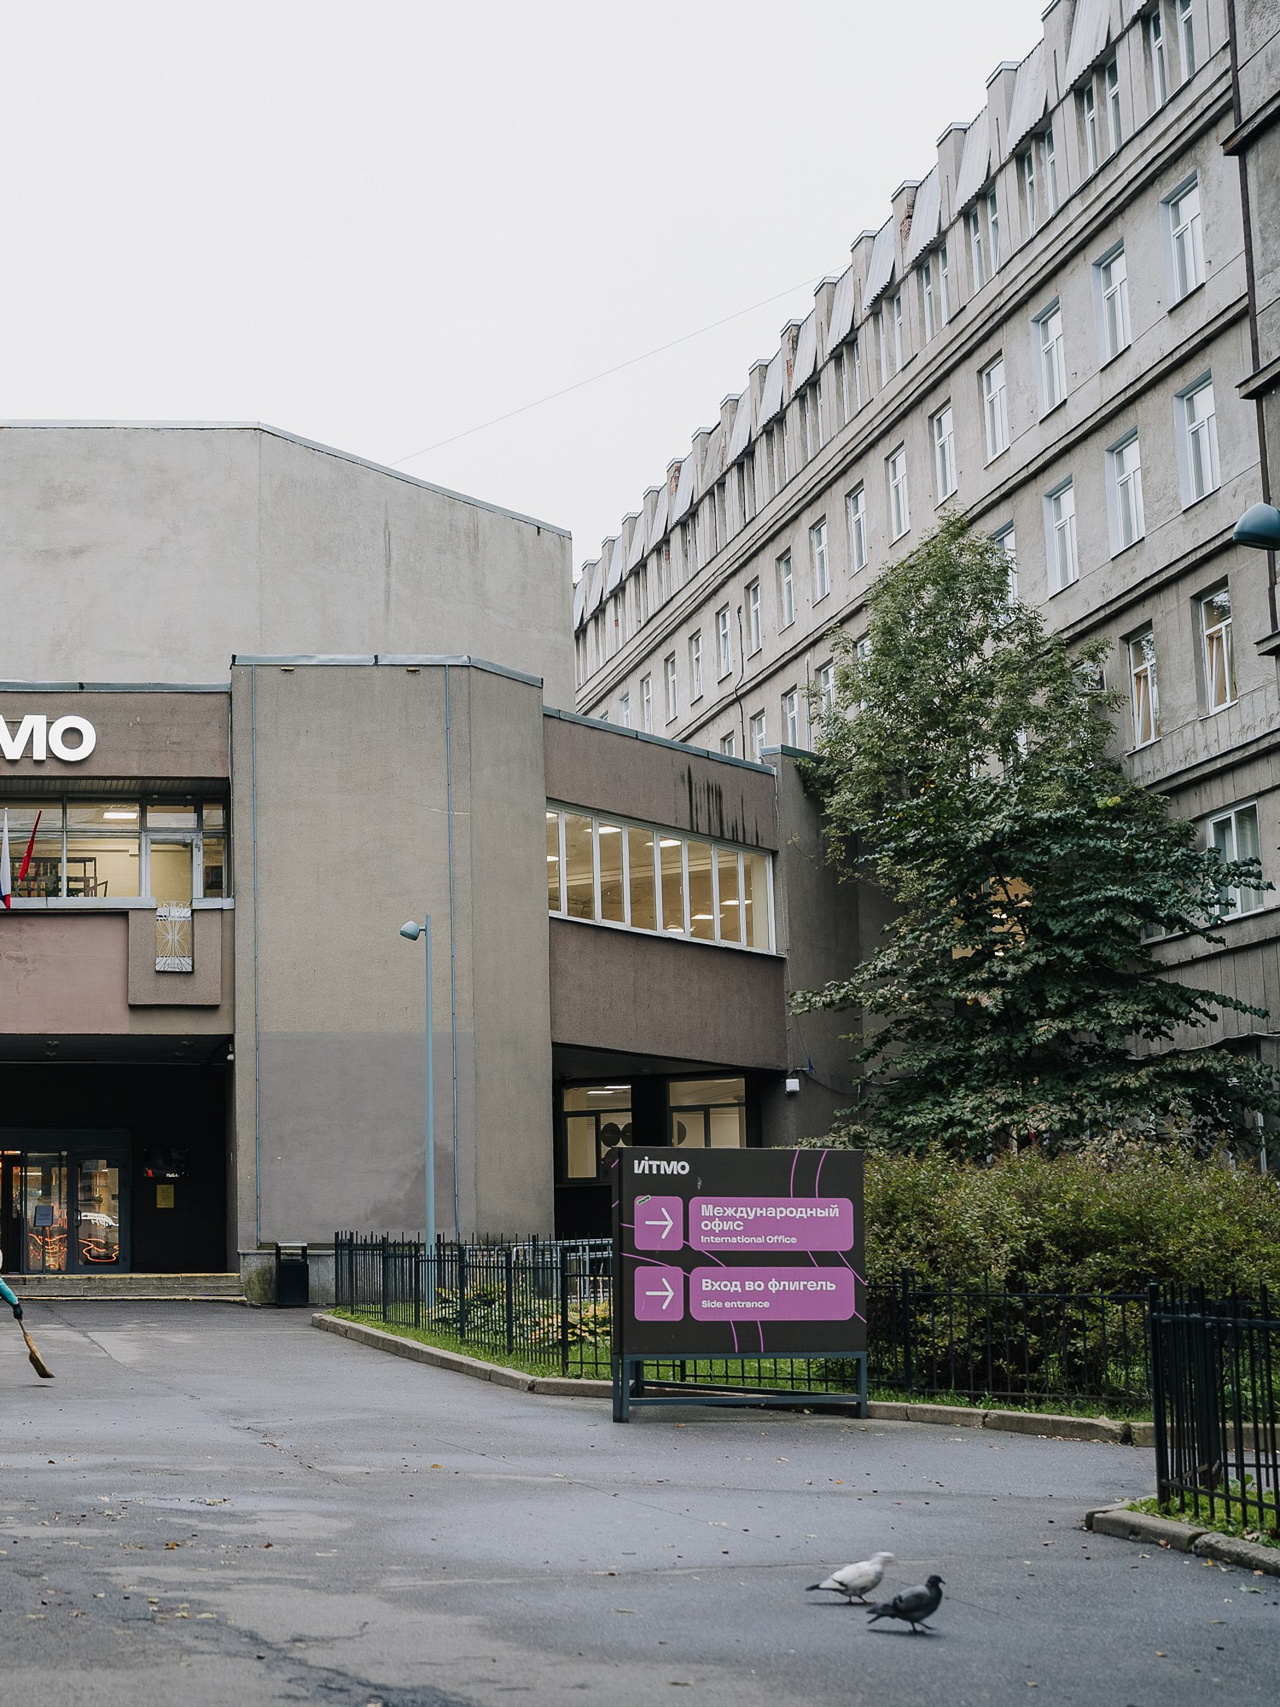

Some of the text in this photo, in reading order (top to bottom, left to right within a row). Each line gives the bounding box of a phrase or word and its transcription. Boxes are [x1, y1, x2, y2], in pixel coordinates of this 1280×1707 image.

[701, 1204, 840, 1219] Международный
[701, 1218, 744, 1232] офис
[701, 1235, 797, 1244] International Office
[701, 1278, 837, 1293] Вход во флигель
[701, 1300, 770, 1308] Side entrance
